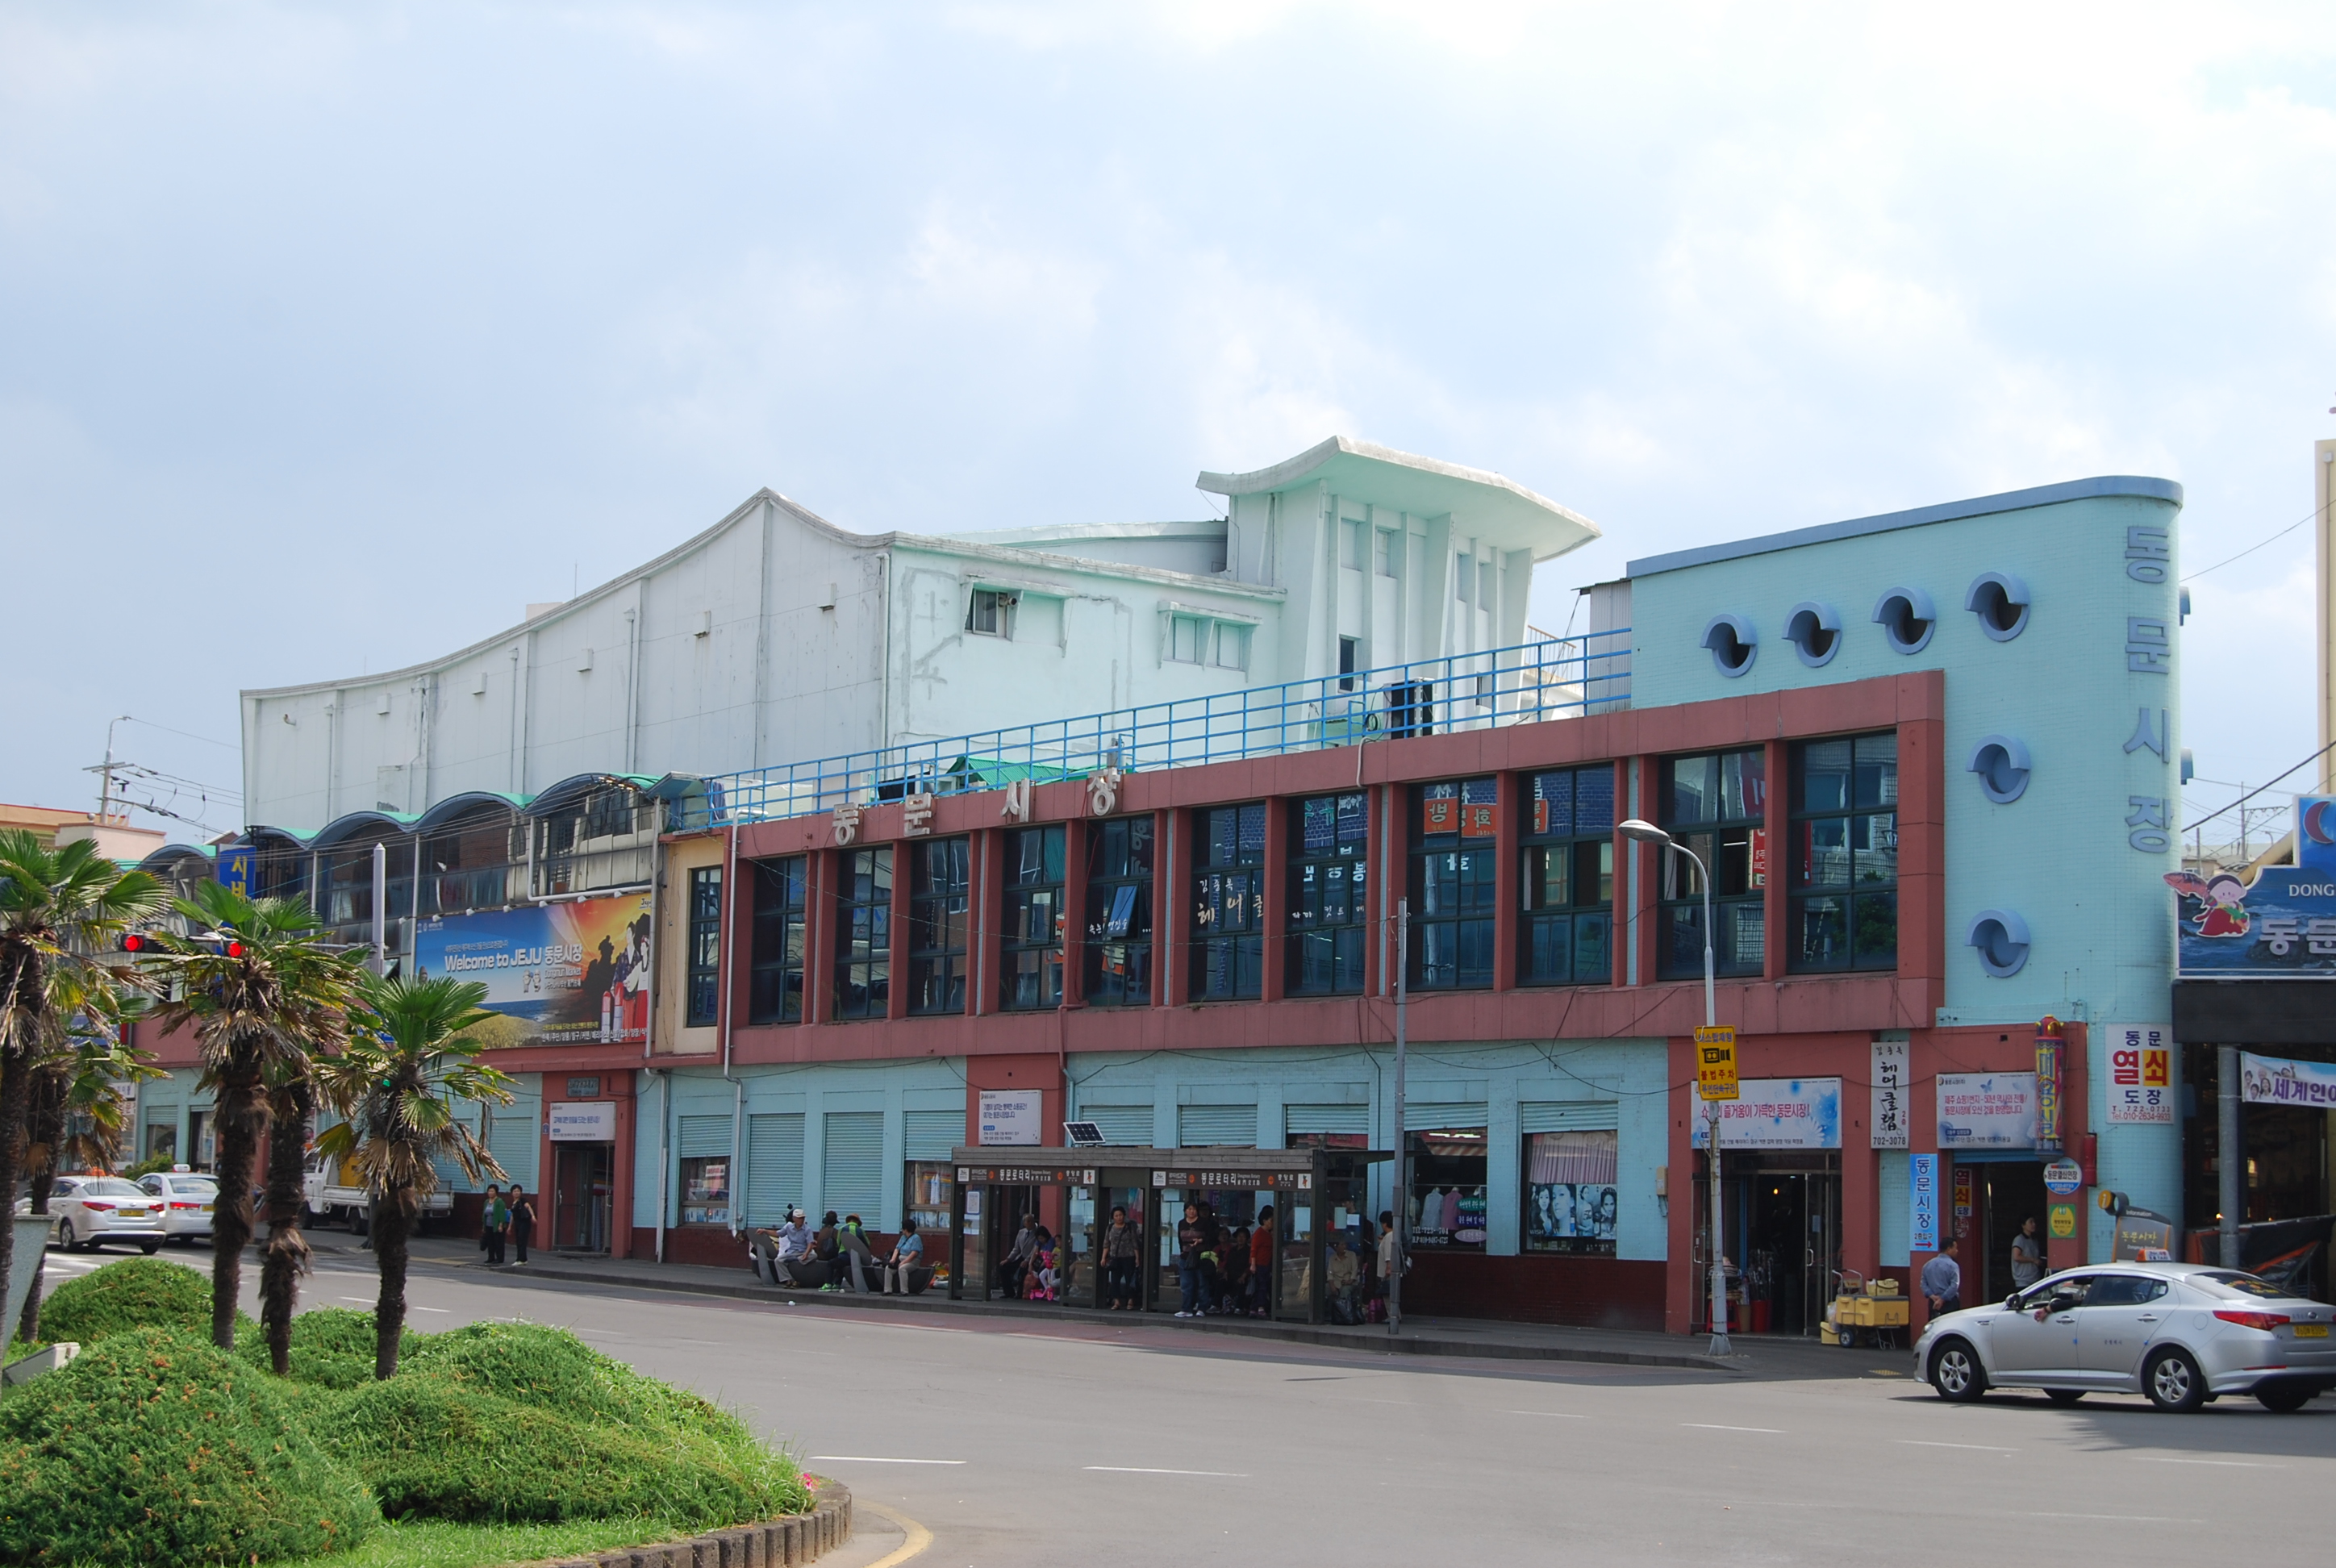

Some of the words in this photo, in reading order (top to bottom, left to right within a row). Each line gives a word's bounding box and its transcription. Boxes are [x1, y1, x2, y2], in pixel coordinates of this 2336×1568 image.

[2123, 526, 2171, 853] 동문시장
[832, 767, 1120, 846] 동문시장
[2259, 919, 2336, 956] 동문
[444, 953, 494, 972] Welcome
[496, 953, 509, 968] to
[511, 947, 542, 966] JEJU
[544, 943, 583, 965] 동문시장
[2125, 1031, 2161, 1046] 동문
[2113, 1050, 2167, 1086] 열쇠
[1880, 1061, 1898, 1131] 헤어클럽
[2125, 1090, 2161, 1106] 도장
[1724, 1104, 1752, 1119] 즐거움이
[1754, 1104, 1775, 1118] 가득한
[1873, 1136, 1906, 1145] 702-3078
[999, 1169, 1030, 1181] 동문로터리
[1201, 1173, 1237, 1186] 동문로터리
[1917, 1157, 1932, 1229] 동문시장
[2121, 1231, 2157, 1244] 동문시장
